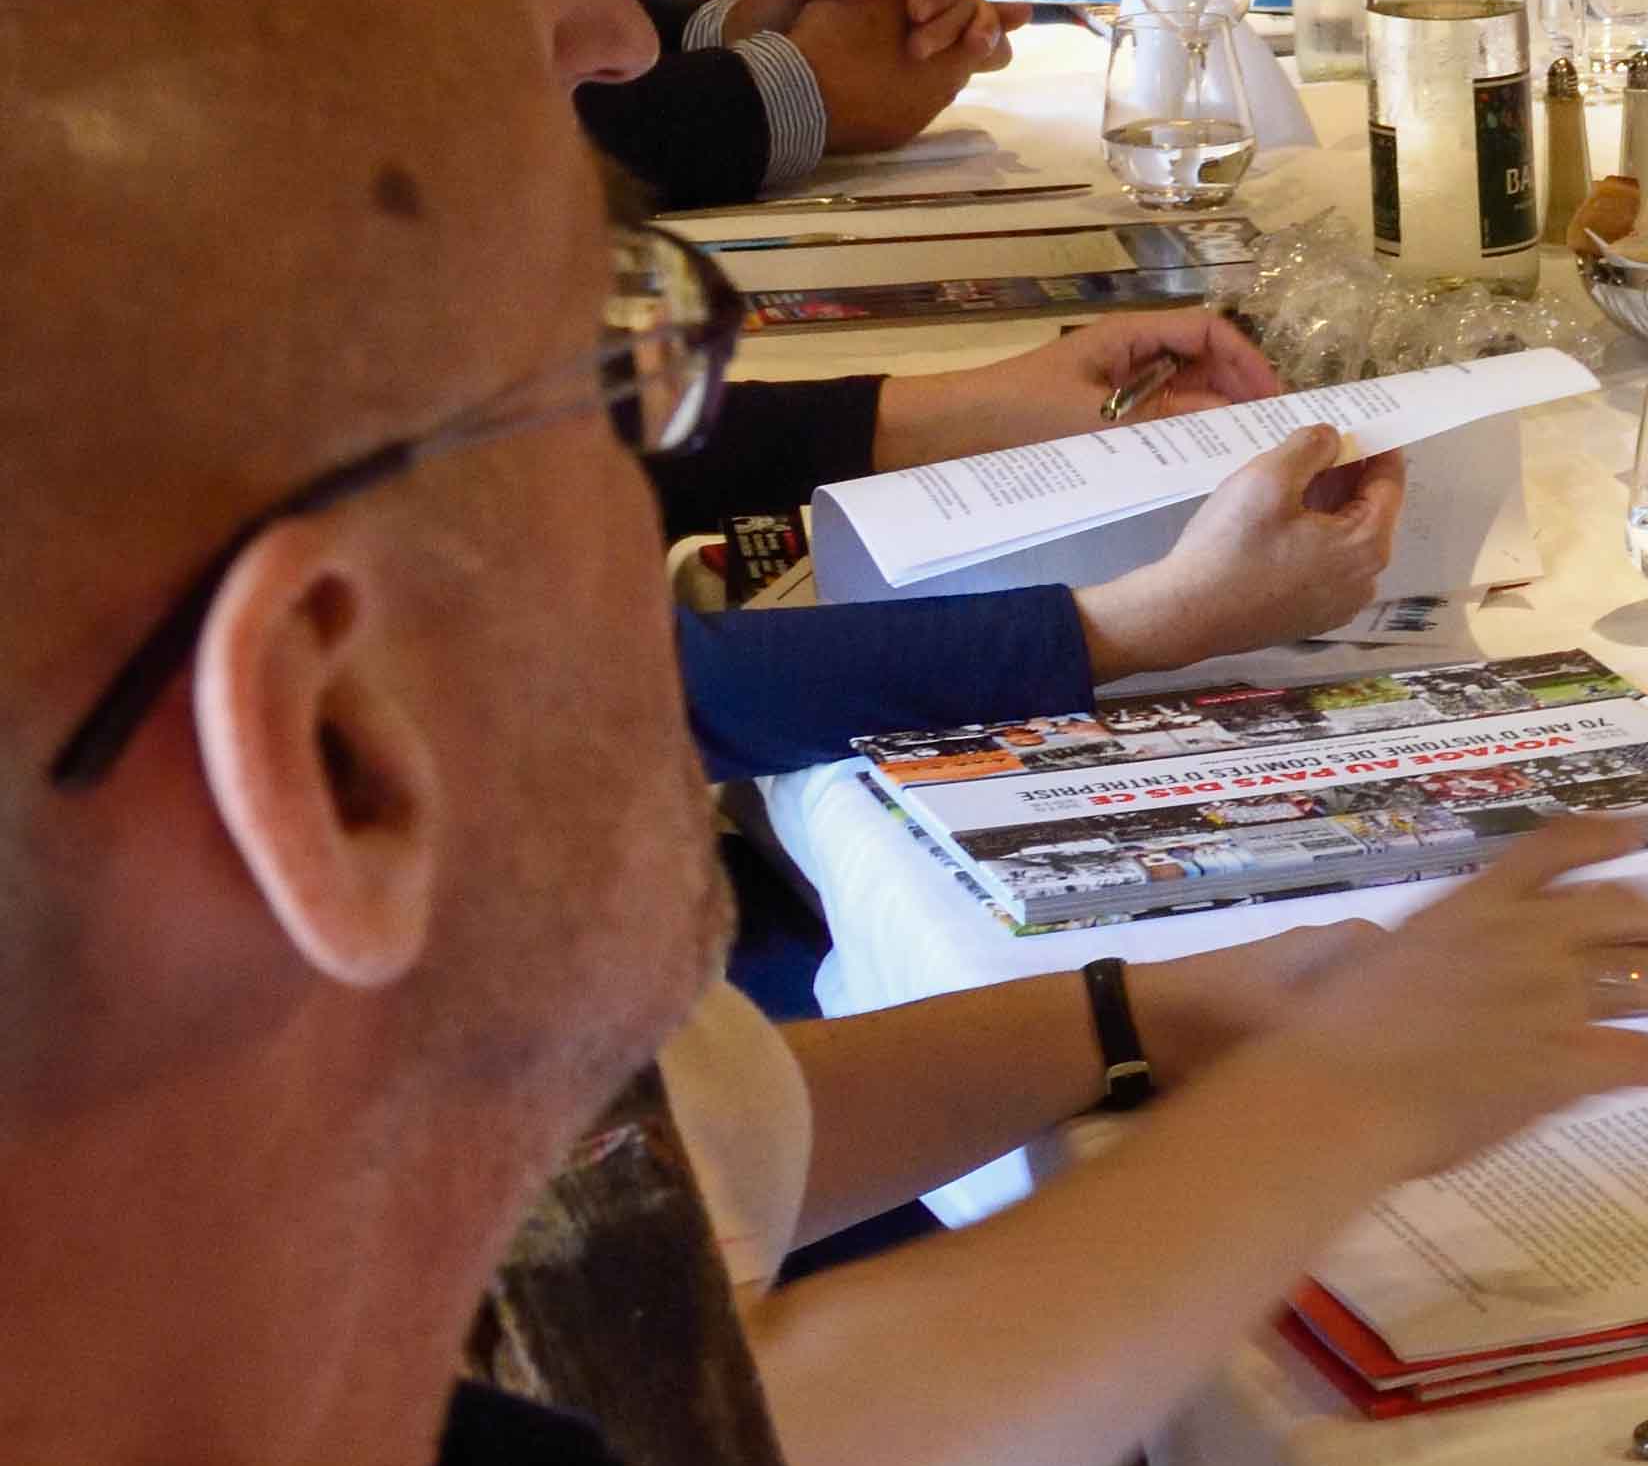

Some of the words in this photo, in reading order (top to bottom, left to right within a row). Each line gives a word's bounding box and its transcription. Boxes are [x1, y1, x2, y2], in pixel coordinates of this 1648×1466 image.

[1414, 736, 1576, 766] VOYAGE
[1345, 758, 1400, 775] AU
[1239, 767, 1338, 788] PAYS
[1149, 781, 1223, 798] DES
[1087, 792, 1138, 806] CE
